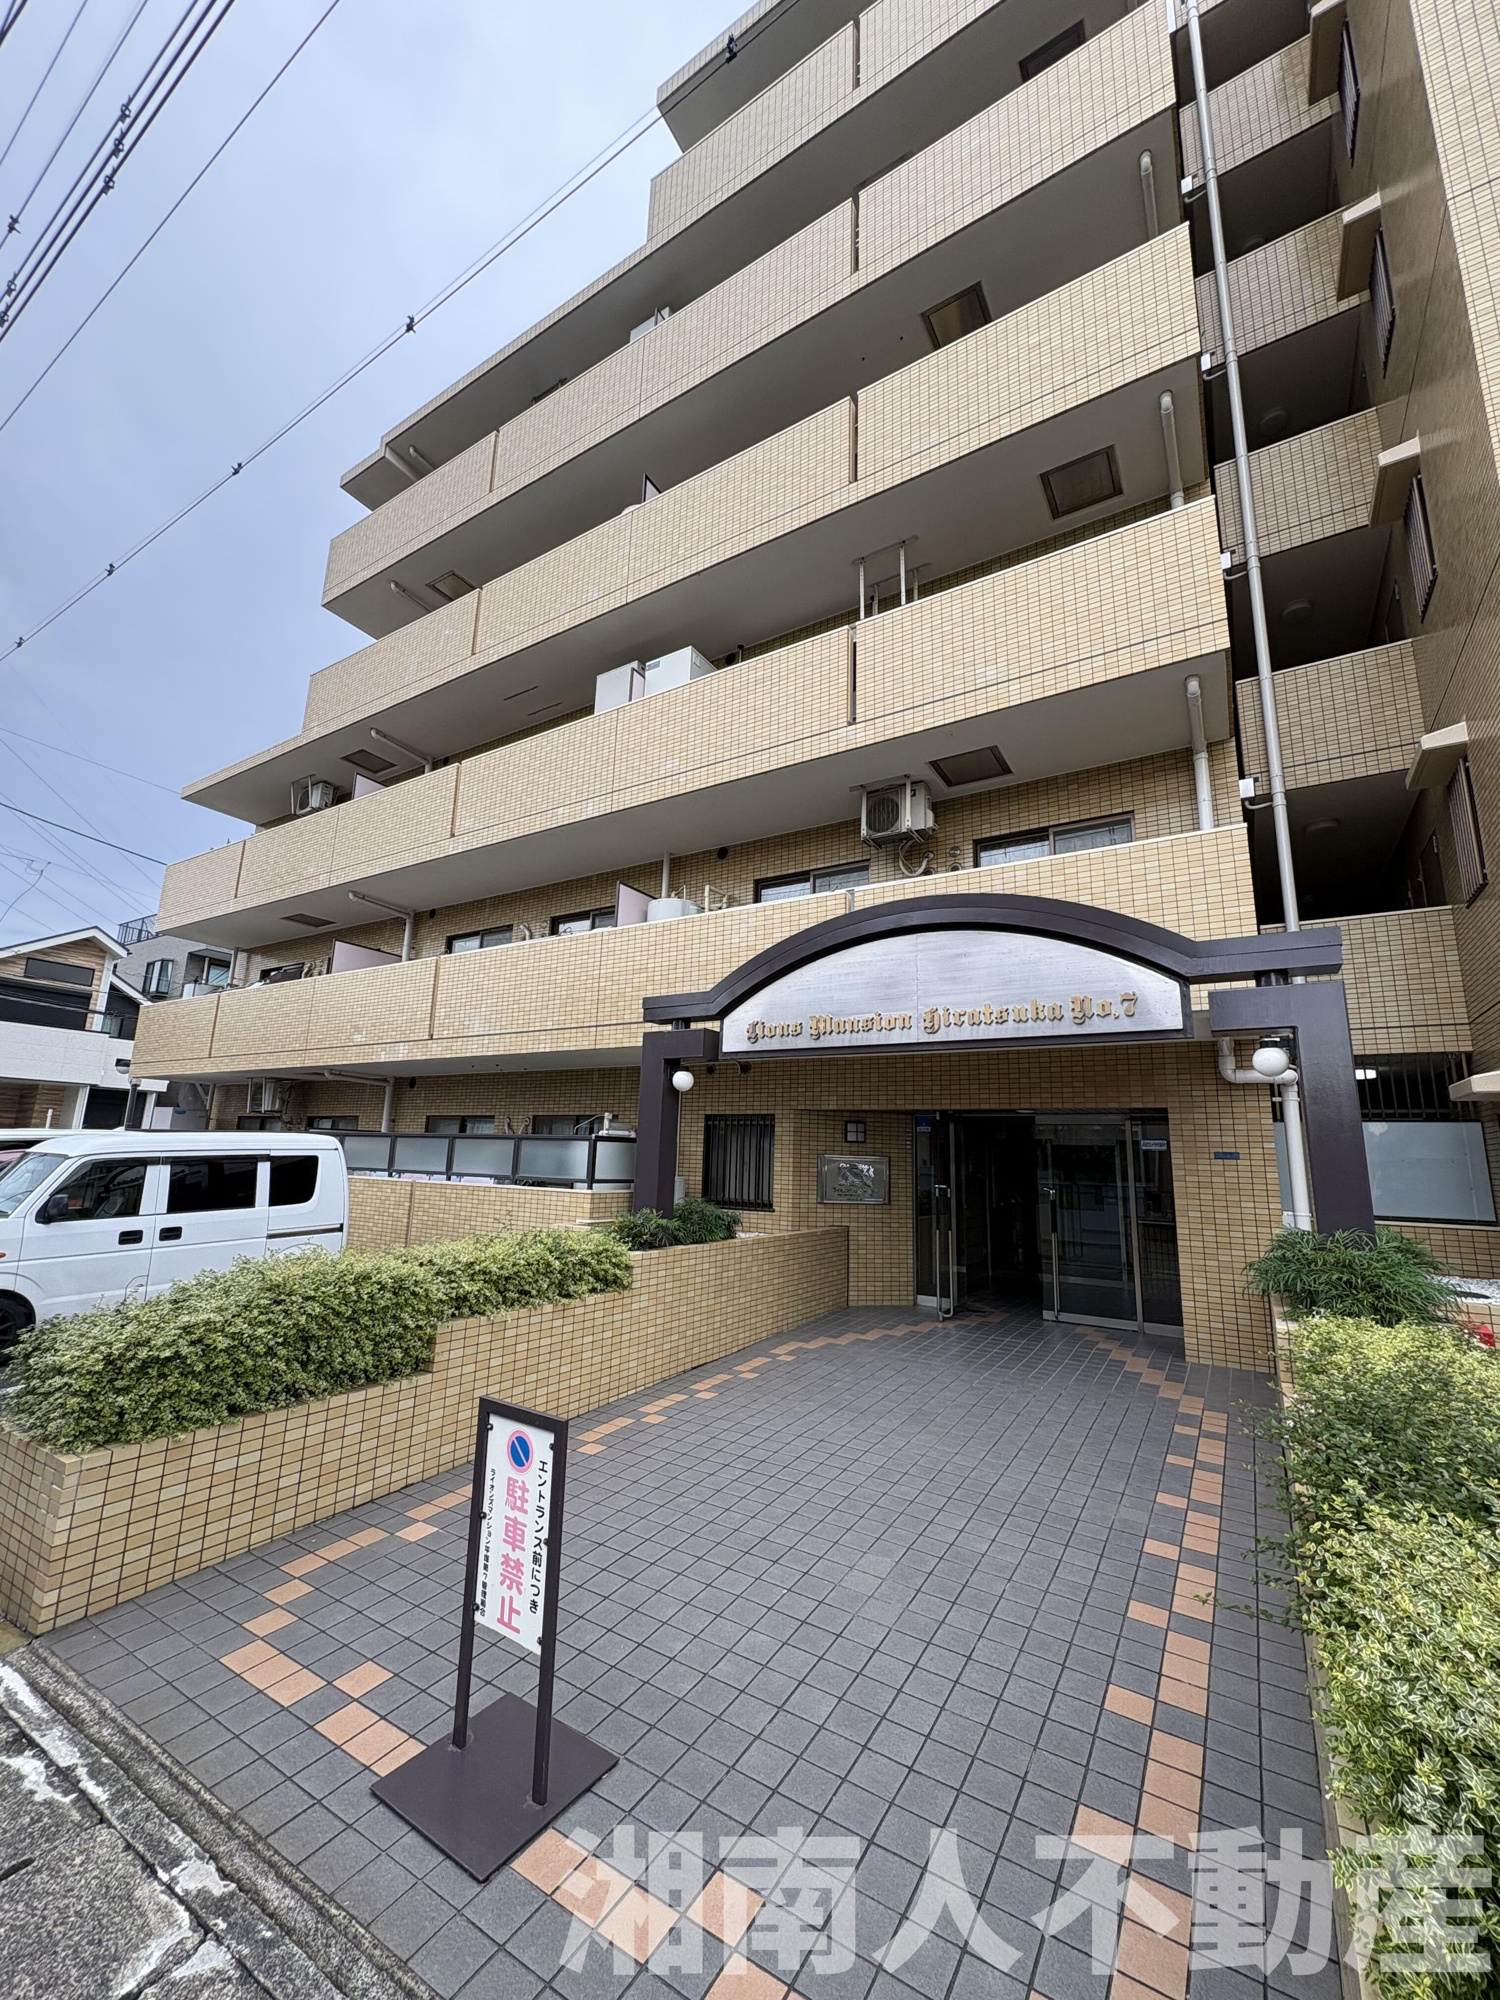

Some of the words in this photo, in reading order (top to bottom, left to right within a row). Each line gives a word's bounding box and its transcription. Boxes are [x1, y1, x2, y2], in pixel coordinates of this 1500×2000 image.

[747, 1019, 803, 1043] Lions
[809, 1011, 912, 1040] Mansion
[922, 998, 1064, 1034] Hiratsuka
[498, 1477, 530, 1634] 駐車禁止
[530, 1460, 548, 1614] エントランス前につき
